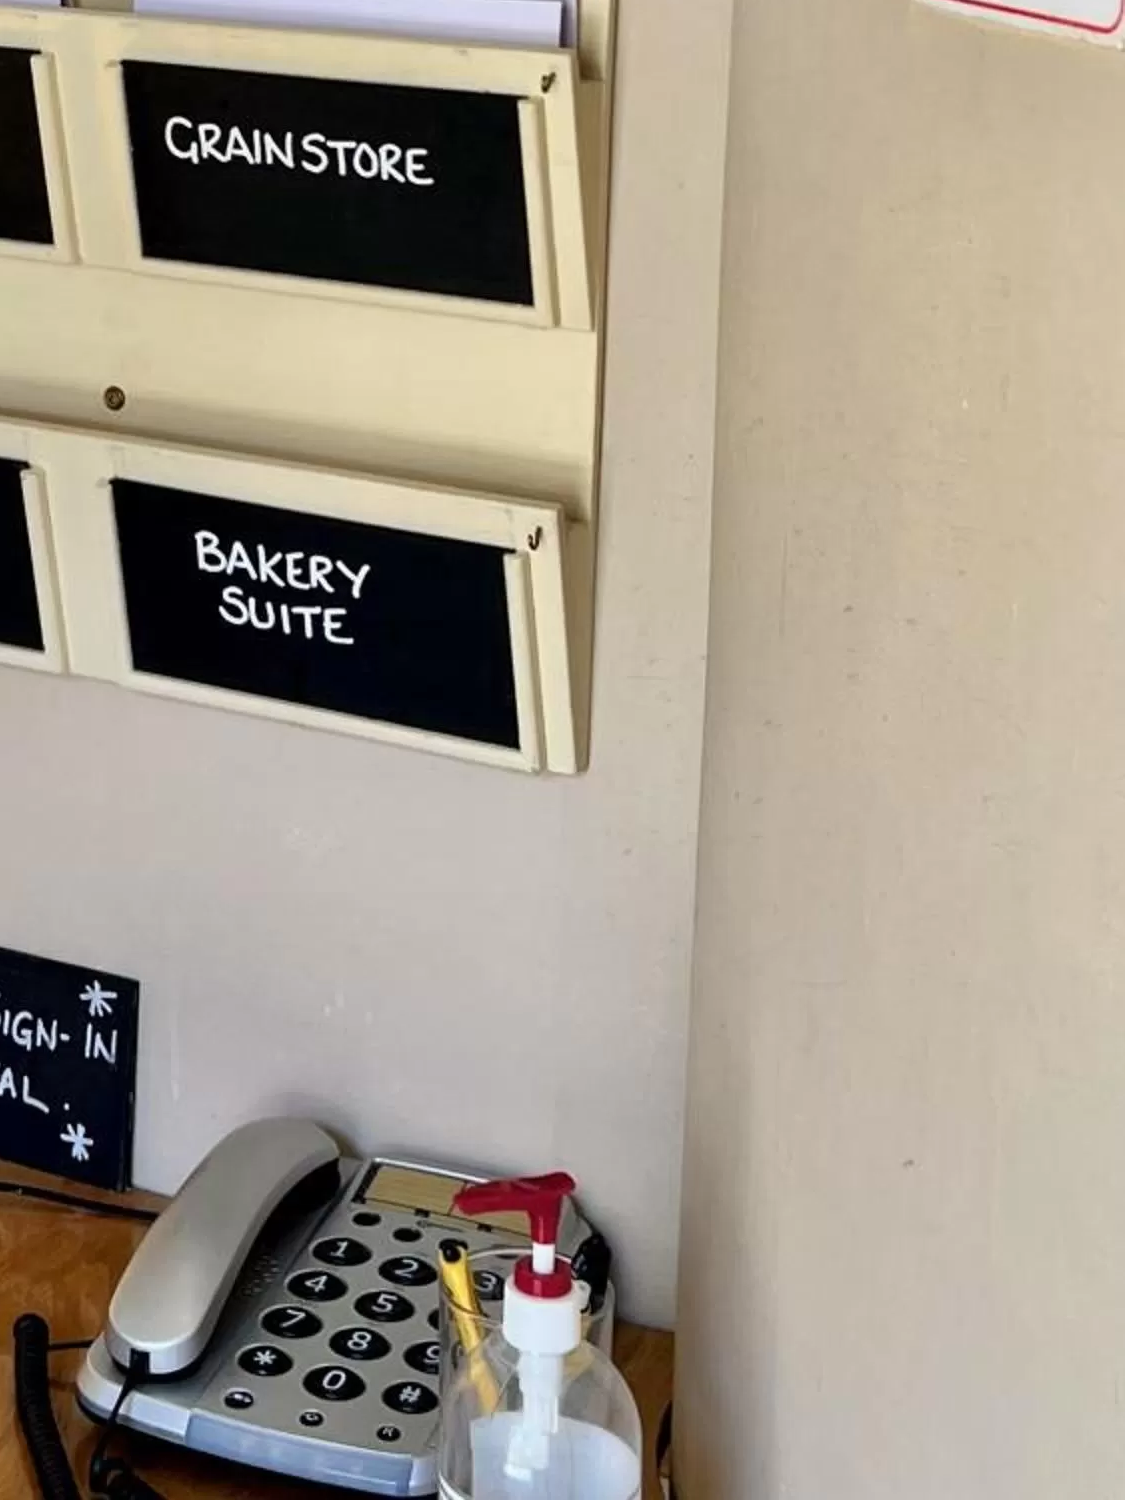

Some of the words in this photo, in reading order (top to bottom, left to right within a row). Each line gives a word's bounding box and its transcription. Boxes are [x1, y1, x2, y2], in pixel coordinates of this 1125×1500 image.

[194, 530, 371, 599] BAKERY
[219, 587, 354, 644] SUITE
[330, 1241, 349, 1258] 1
[394, 1259, 420, 1278] 2
[304, 1275, 328, 1294] 4
[478, 1273, 497, 1292] 3
[372, 1294, 398, 1313] 5
[280, 1308, 306, 1328] 7
[346, 1330, 372, 1351] 8
[321, 1370, 346, 1391] 0
